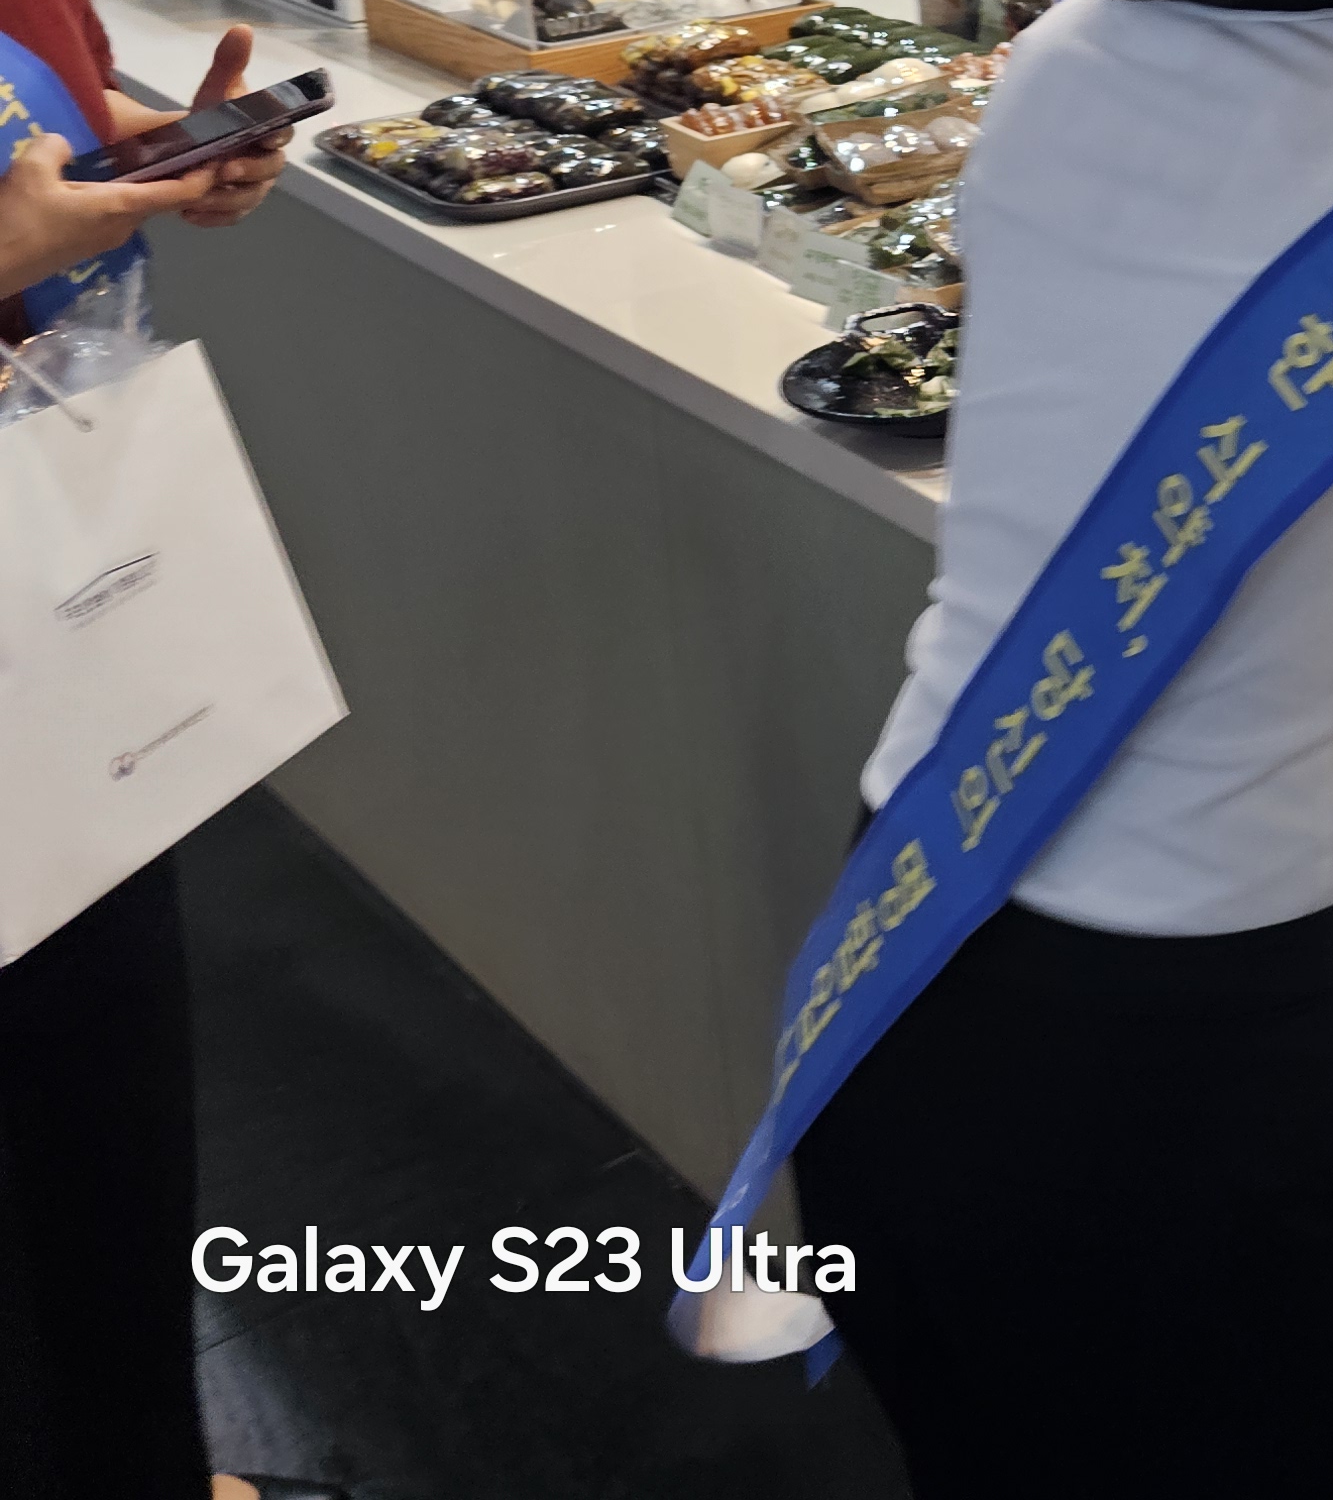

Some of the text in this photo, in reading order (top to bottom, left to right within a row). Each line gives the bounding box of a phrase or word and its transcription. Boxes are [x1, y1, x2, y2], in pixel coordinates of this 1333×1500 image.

[1100, 415, 1267, 658] 식약처,
[953, 629, 1096, 853] 당신의
[769, 836, 938, 1106] 명함입니
